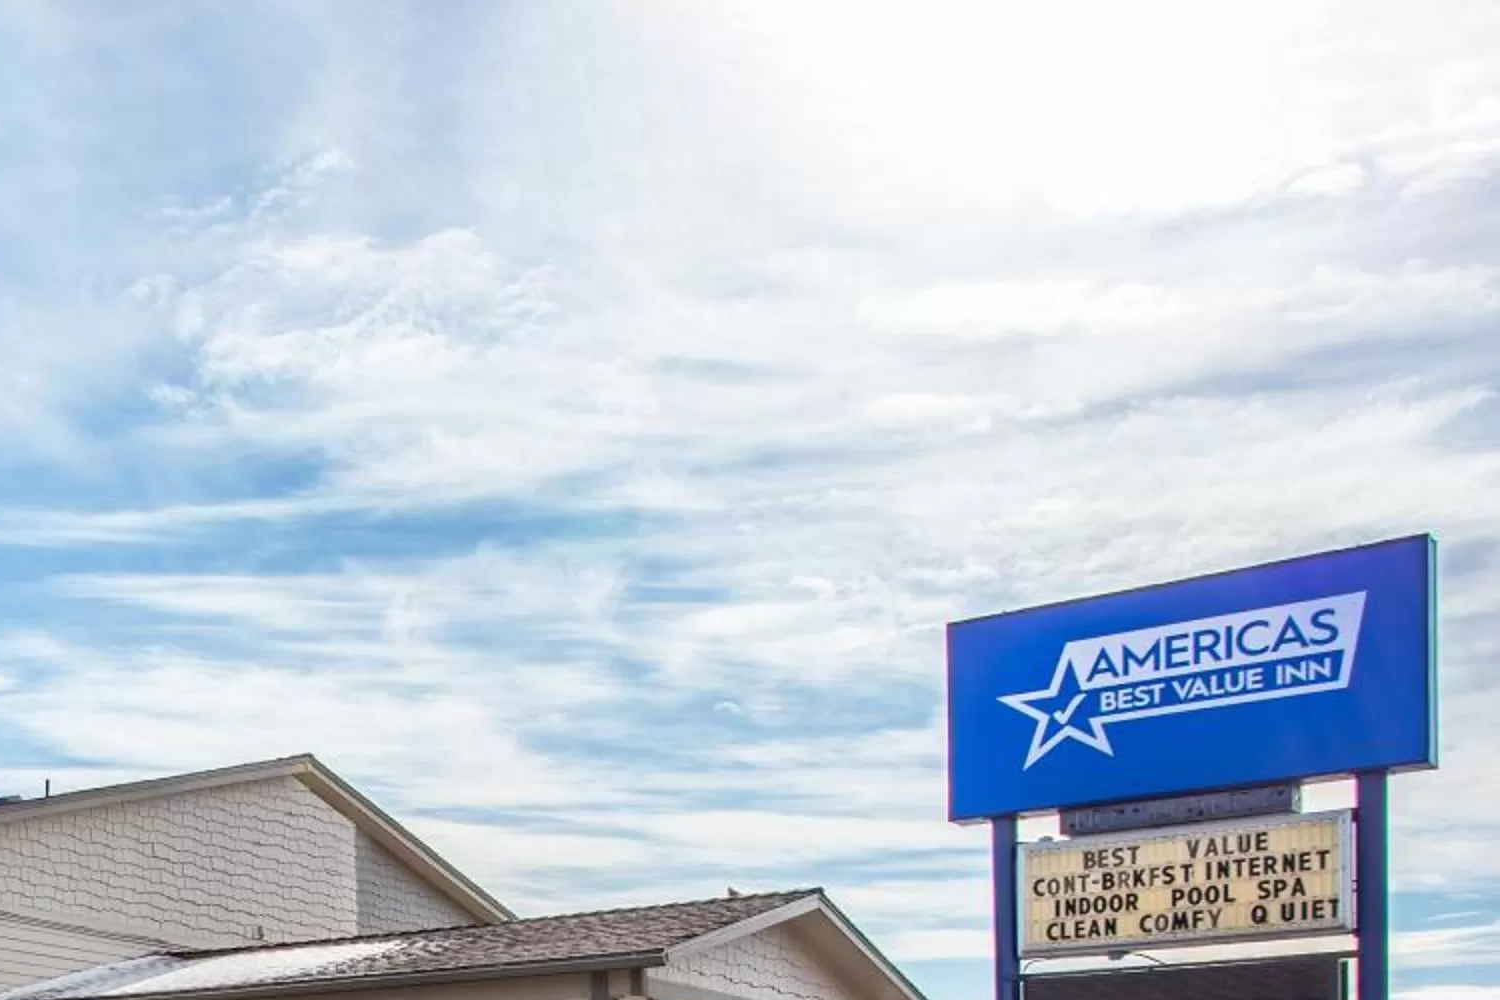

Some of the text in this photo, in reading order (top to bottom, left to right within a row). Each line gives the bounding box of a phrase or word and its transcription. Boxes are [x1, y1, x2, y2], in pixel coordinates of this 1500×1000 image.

[1085, 607, 1339, 682] AMERICAS
[1100, 658, 1332, 712] BEST VALUE INN
[1033, 850, 1330, 897] CONT-BRKFST INTERNET
[1083, 832, 1269, 871] BEST VALUE
[1046, 898, 1339, 941] CLEAN COMFY QUIET
[1055, 877, 1306, 918] INDOOR POOL SPA
